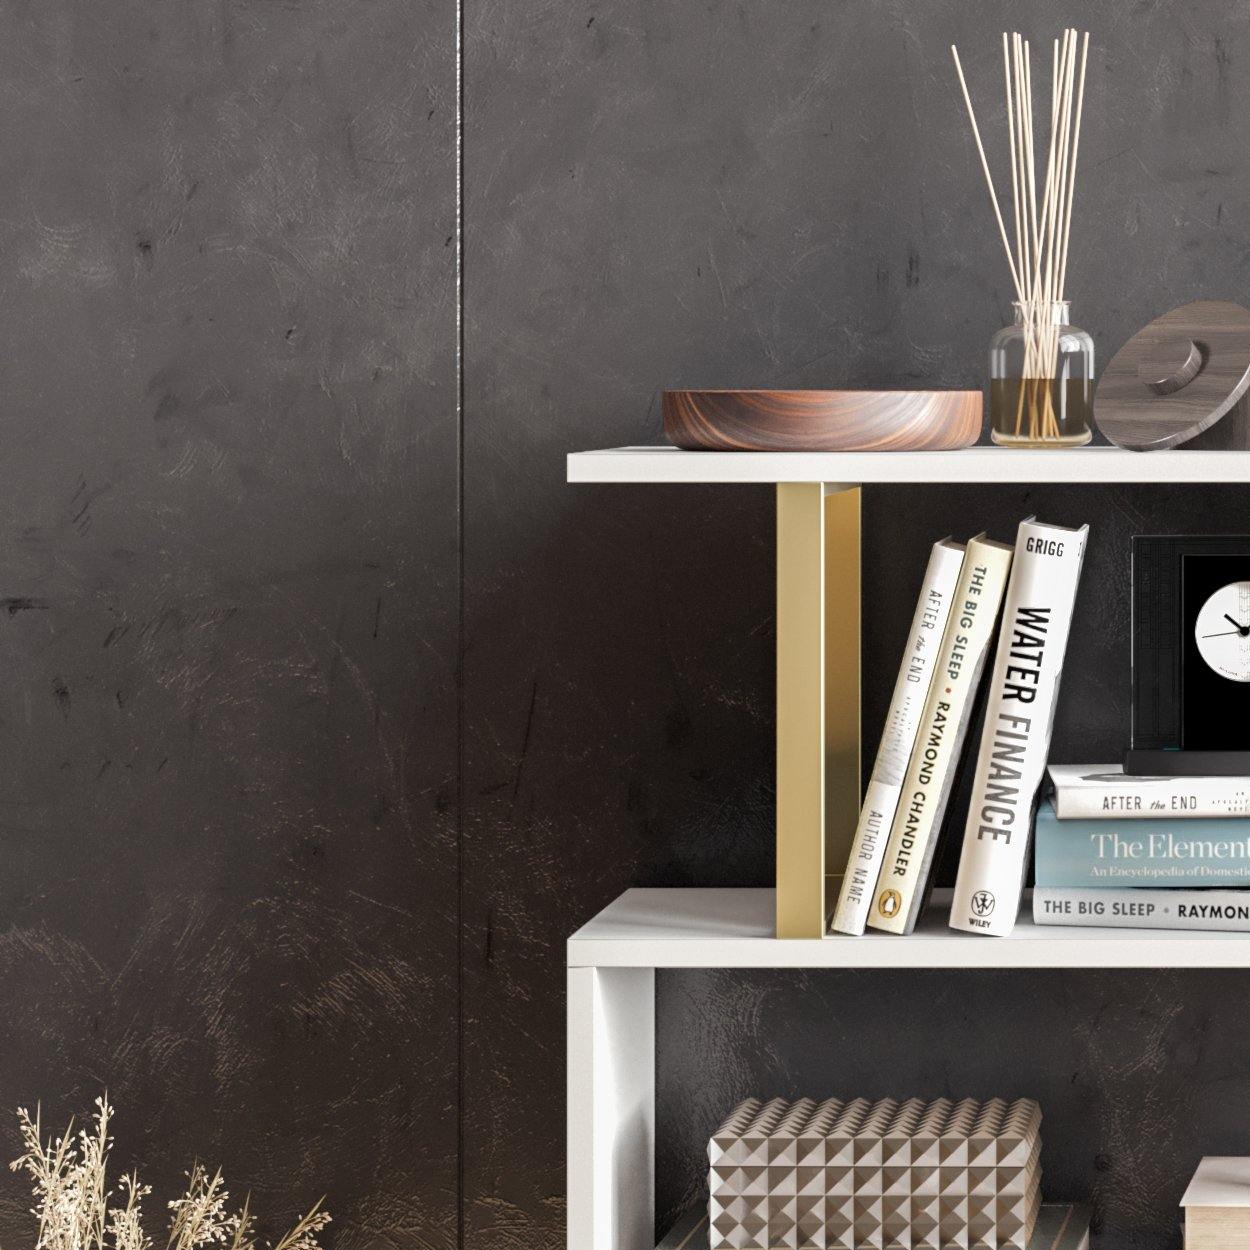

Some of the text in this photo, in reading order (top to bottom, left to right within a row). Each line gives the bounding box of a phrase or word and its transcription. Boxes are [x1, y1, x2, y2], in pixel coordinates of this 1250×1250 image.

[1026, 537, 1065, 557] GRIGG
[968, 567, 987, 596] THE
[960, 599, 978, 629] BIG
[950, 635, 969, 680] SLEEP
[977, 607, 1051, 845] WATER FINANCE
[847, 590, 943, 905] AFTER the END AUTHOR NAME
[918, 701, 951, 785] RAYMOND
[1103, 796, 1142, 810] AFTER
[1150, 800, 1166, 810] the
[1171, 796, 1197, 810] END
[893, 792, 926, 876] CHANDLER
[1091, 833, 1143, 859] The
[1091, 866, 1107, 877] An
[1109, 866, 1185, 880] Encyclopedia
[1186, 866, 1199, 877] of
[1044, 901, 1071, 913] THE
[1078, 902, 1105, 915] BIG
[1112, 903, 1155, 916] SLEEP
[969, 918, 991, 929] WILEY
